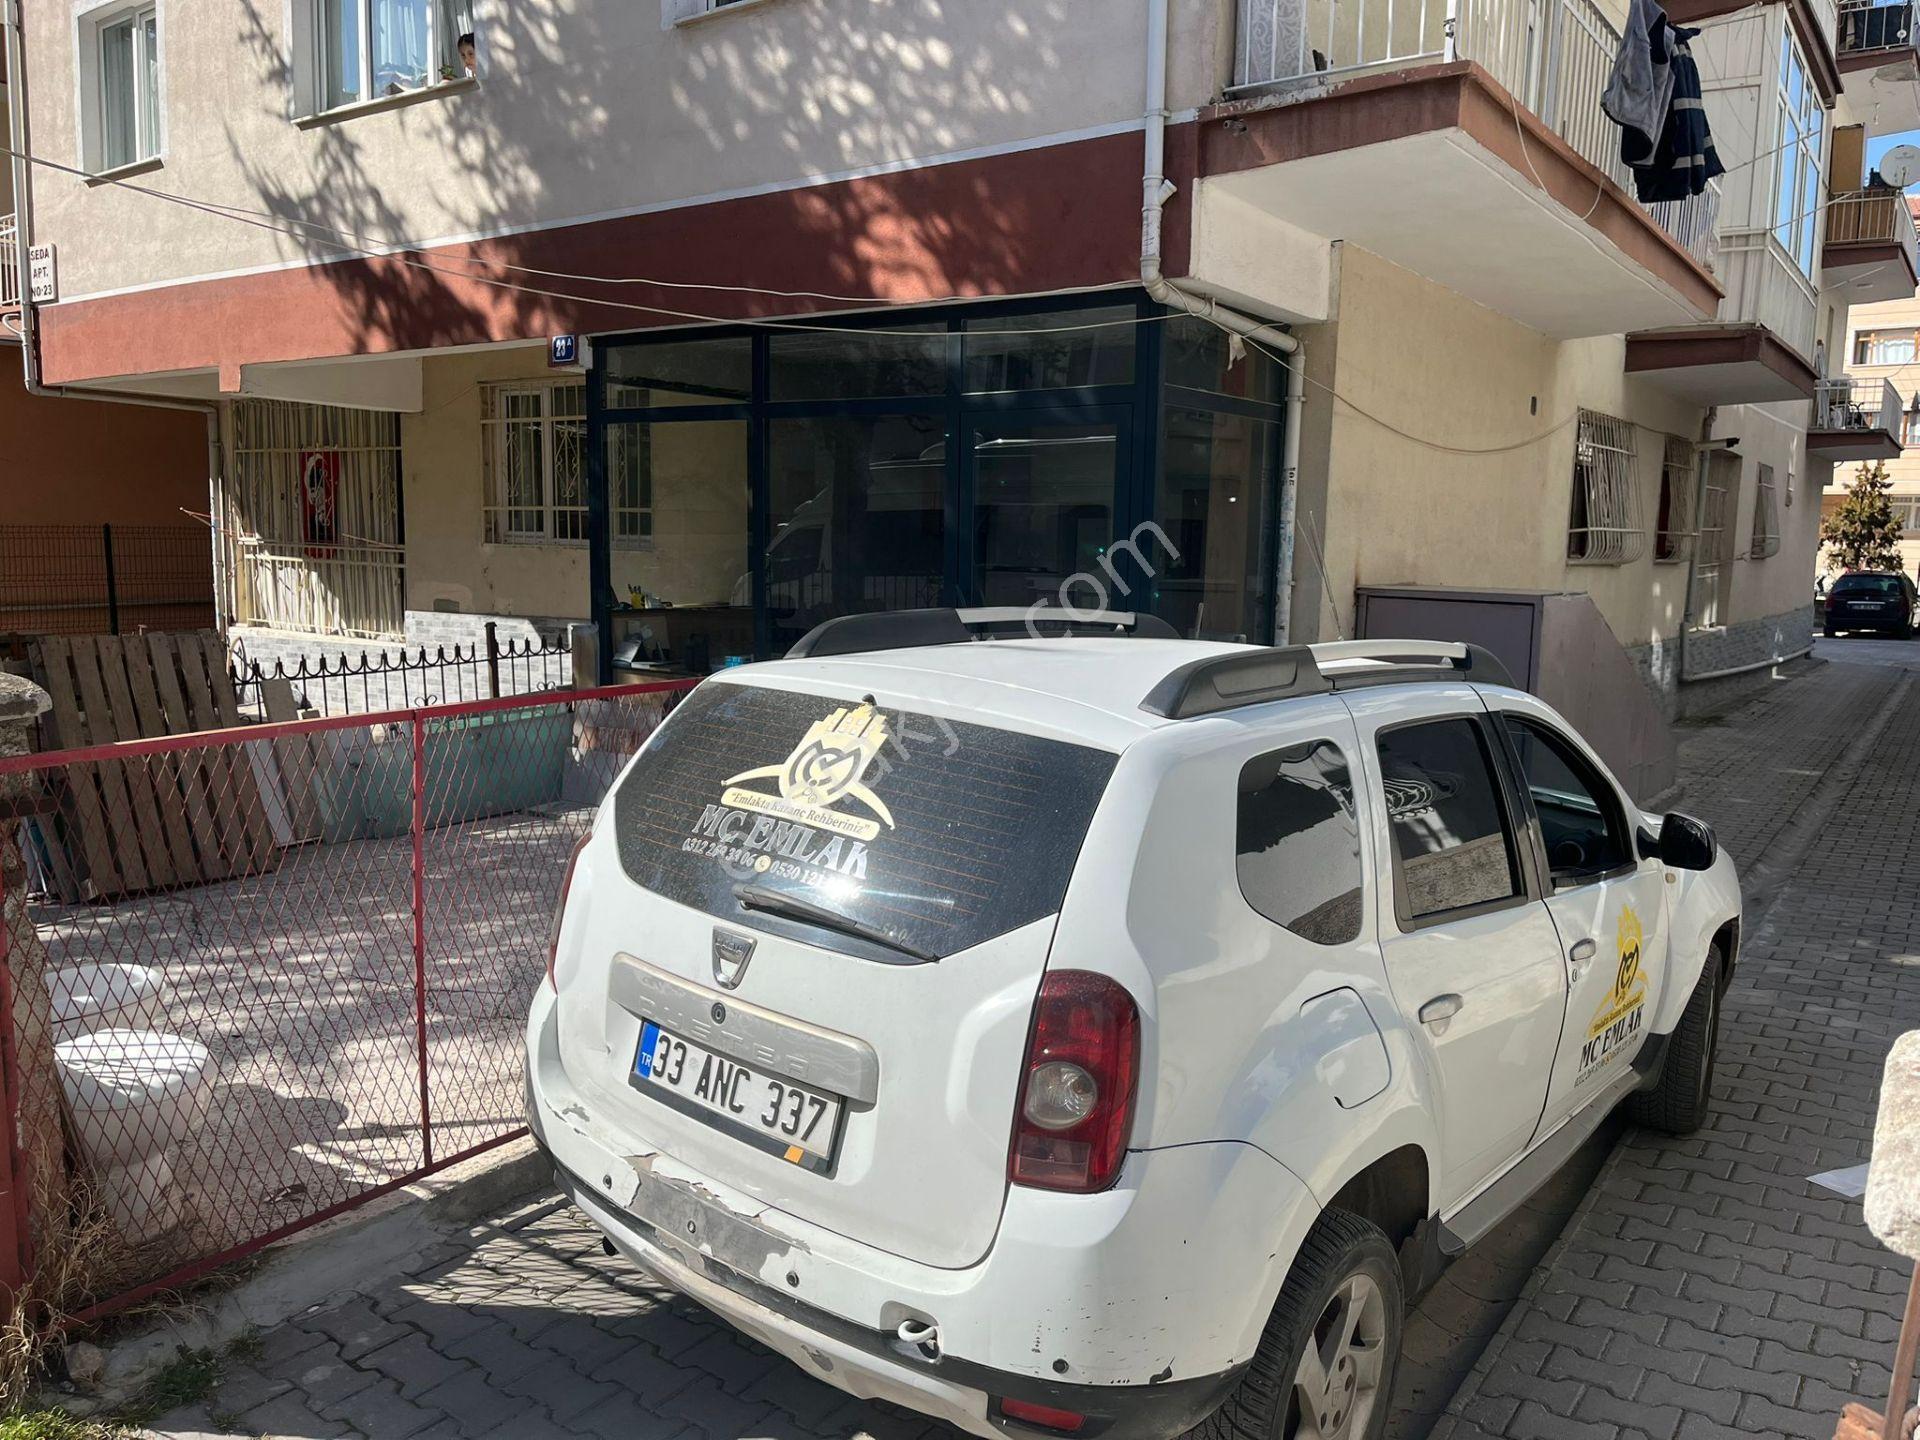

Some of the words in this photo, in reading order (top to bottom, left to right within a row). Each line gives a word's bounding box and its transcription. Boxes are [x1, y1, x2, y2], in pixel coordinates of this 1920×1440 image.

[30, 248, 49, 260] SEDA
[555, 338, 566, 357] 23
[692, 804, 750, 844] MC
[744, 816, 868, 880] EMLAK
[769, 860, 800, 880] 0530
[1578, 1035, 1601, 1073] MC
[1600, 1003, 1645, 1056] EMLAK
[641, 1051, 652, 1069] TR
[652, 1034, 687, 1085] 33
[694, 1053, 751, 1114] ANC
[761, 1081, 828, 1142] 337
